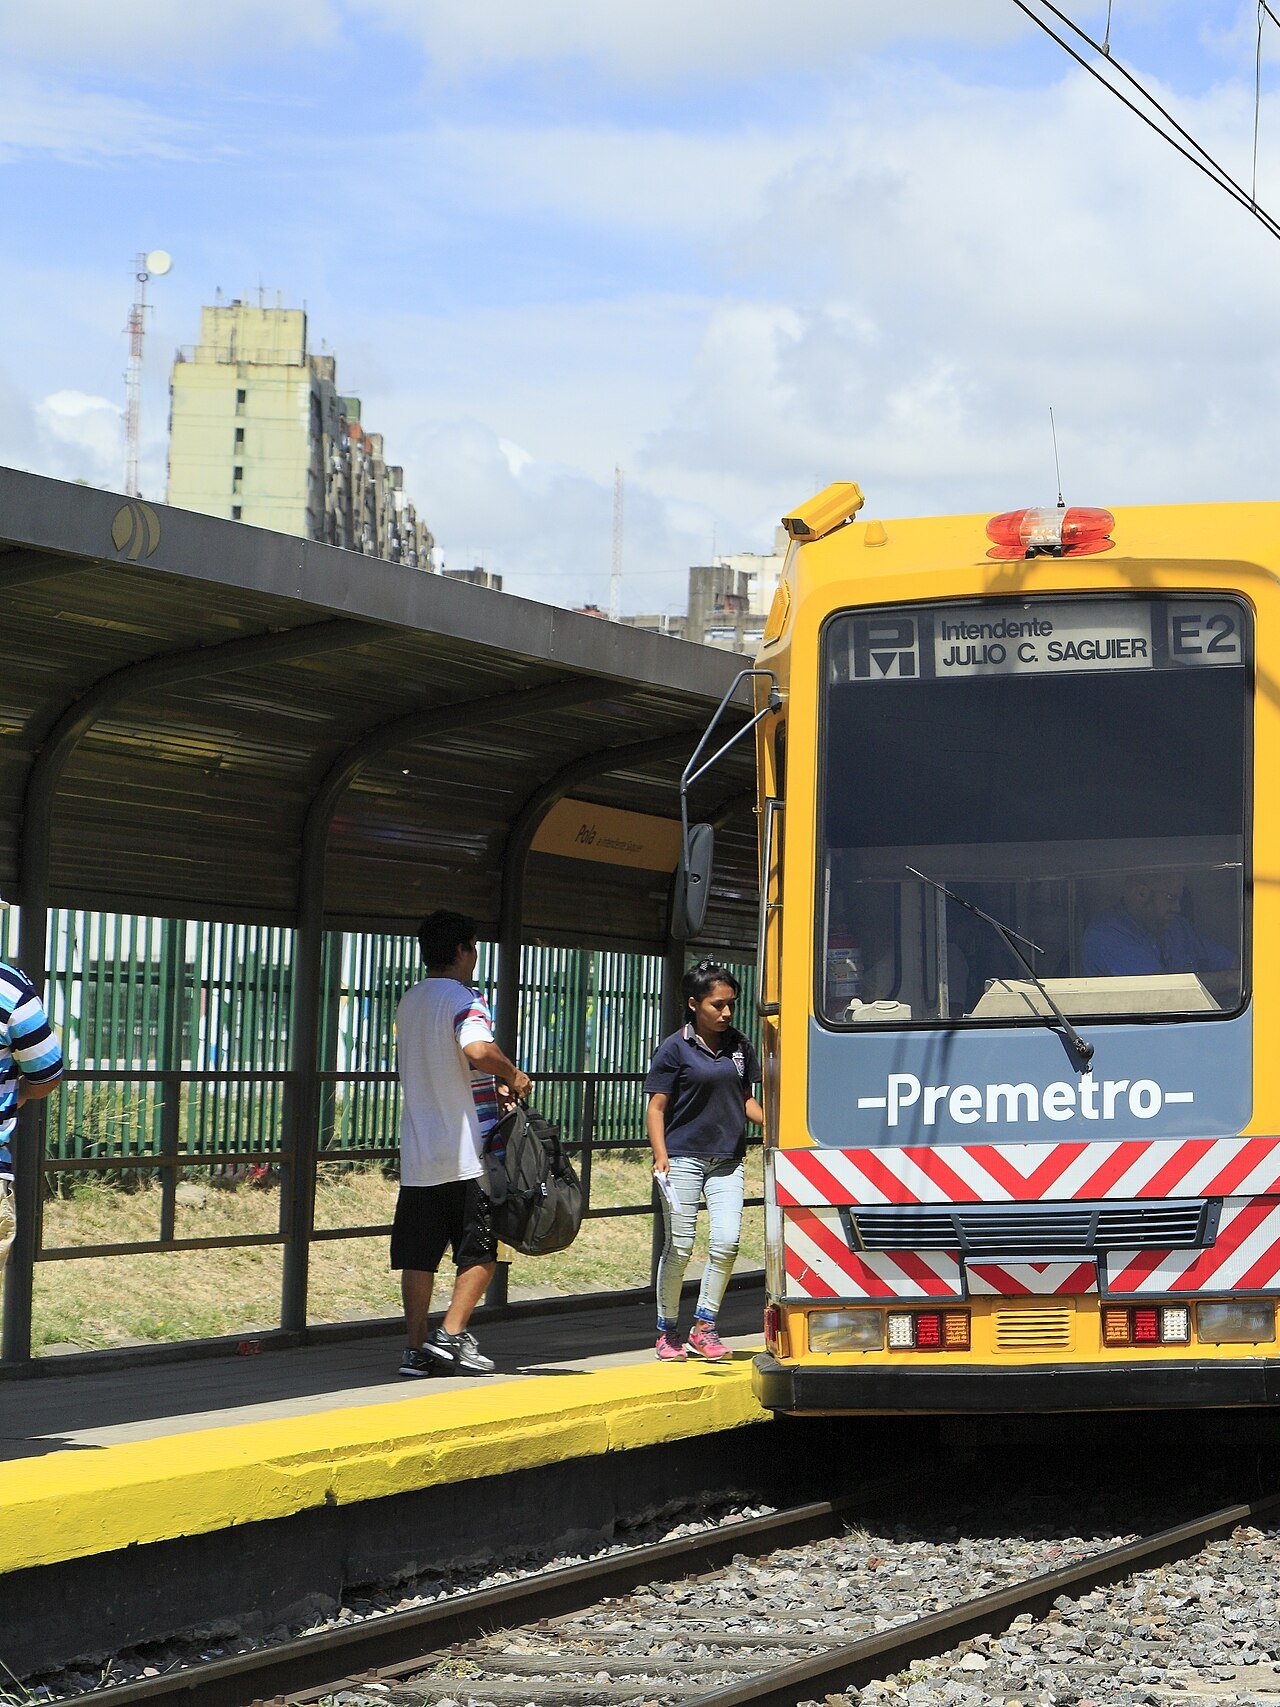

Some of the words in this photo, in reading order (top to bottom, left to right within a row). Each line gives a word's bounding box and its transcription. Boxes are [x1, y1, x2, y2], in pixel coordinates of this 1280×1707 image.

[942, 616, 1053, 641] Intendente
[1172, 614, 1236, 656] E2
[943, 644, 1006, 667] JULIO
[1017, 642, 1039, 664] C.
[1048, 638, 1148, 661] SAGUIER
[575, 824, 597, 845] Pola
[887, 1072, 1162, 1127] Premetro
